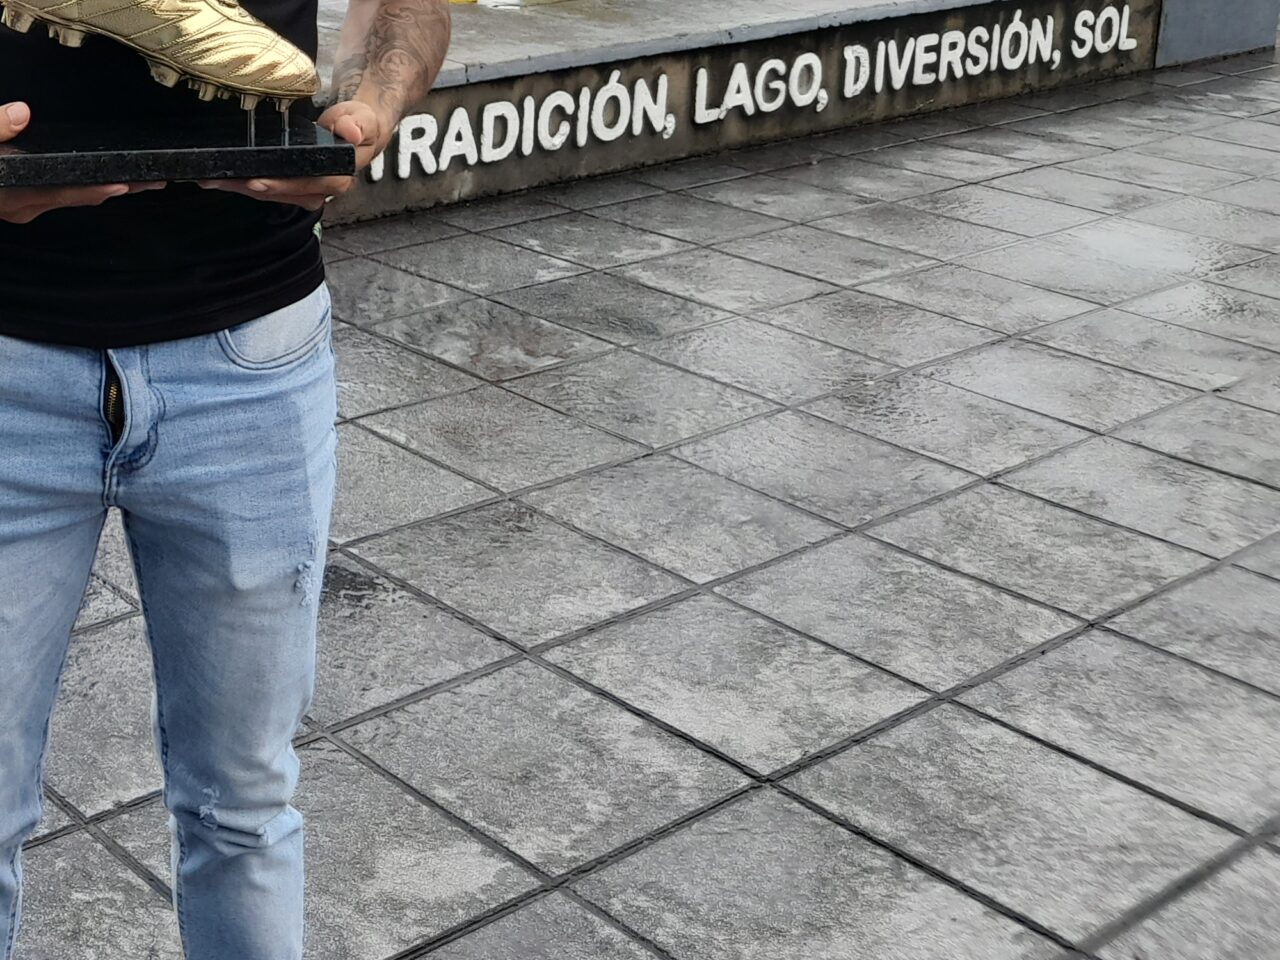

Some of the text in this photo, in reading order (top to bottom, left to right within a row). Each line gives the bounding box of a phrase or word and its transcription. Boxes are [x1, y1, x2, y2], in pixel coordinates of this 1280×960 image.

[694, 52, 829, 124] LAGO,
[843, 9, 1061, 98] DIVERSIÓN,
[1071, 4, 1137, 59] SOL
